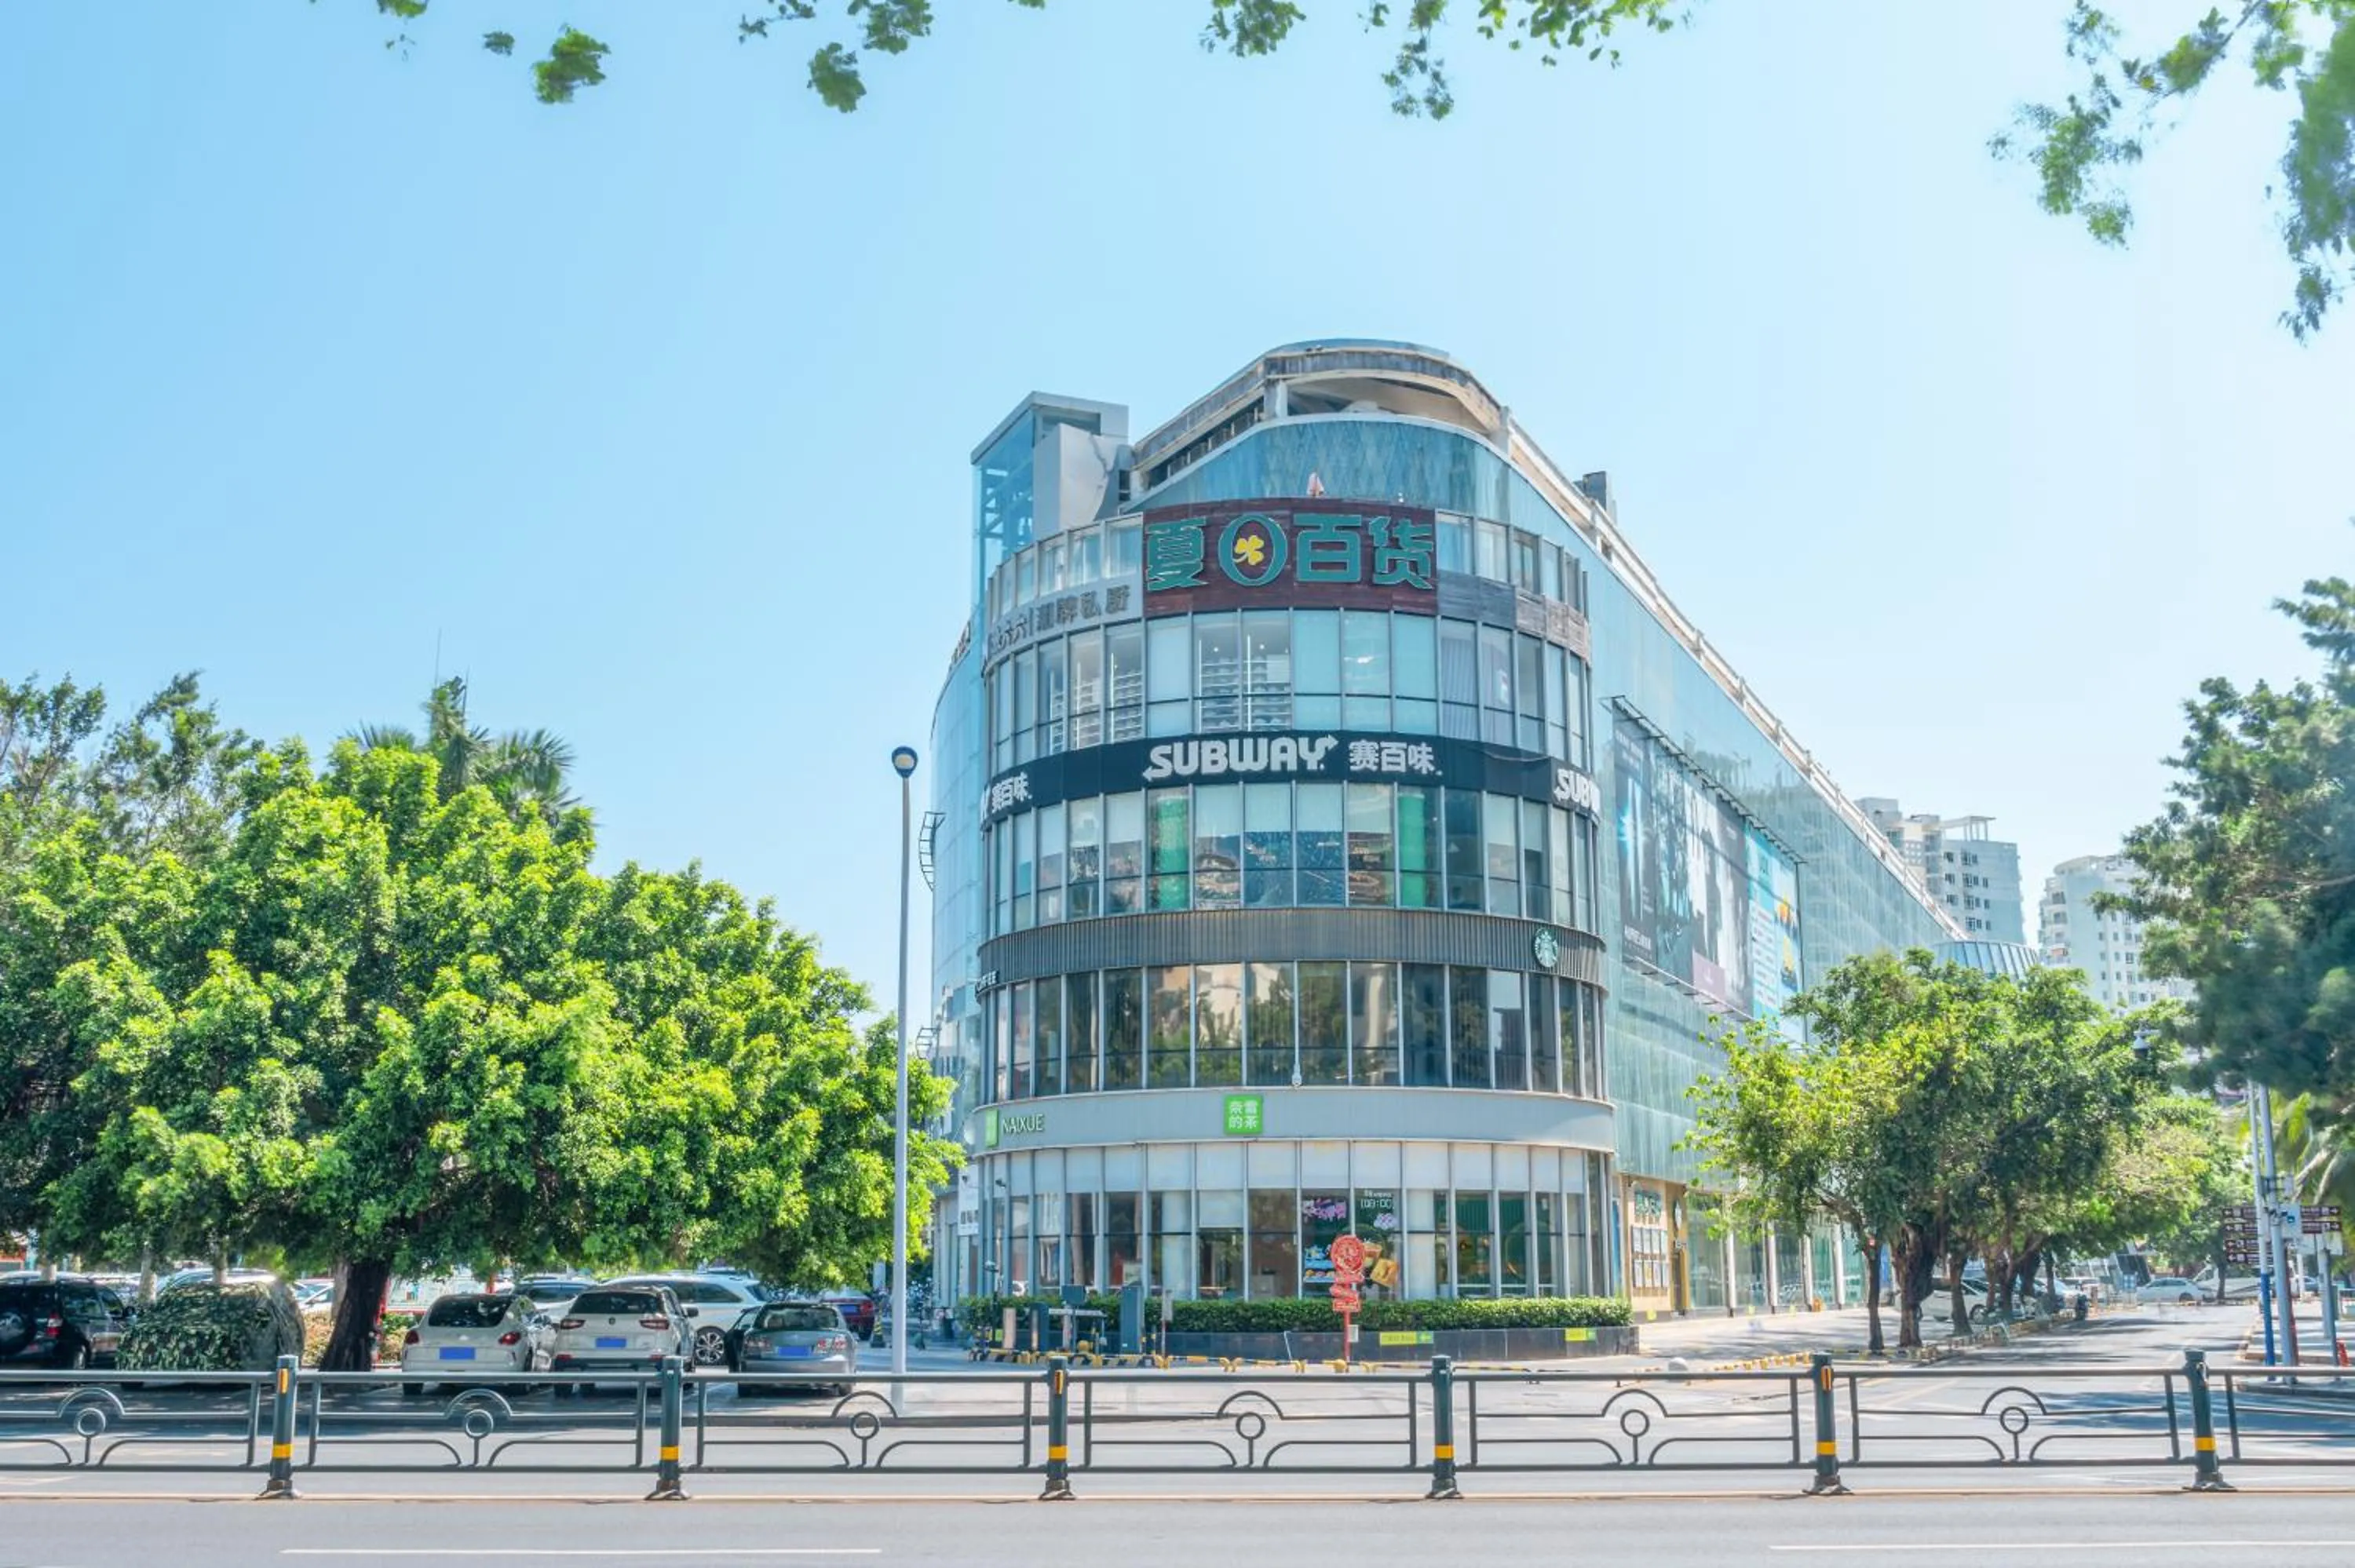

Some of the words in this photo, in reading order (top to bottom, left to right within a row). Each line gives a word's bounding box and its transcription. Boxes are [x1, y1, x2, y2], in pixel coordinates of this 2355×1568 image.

[1142, 735, 1338, 782] SUBWAY
[1348, 739, 1436, 775] 赛百味
[1002, 1114, 1044, 1133] NAIXUE
